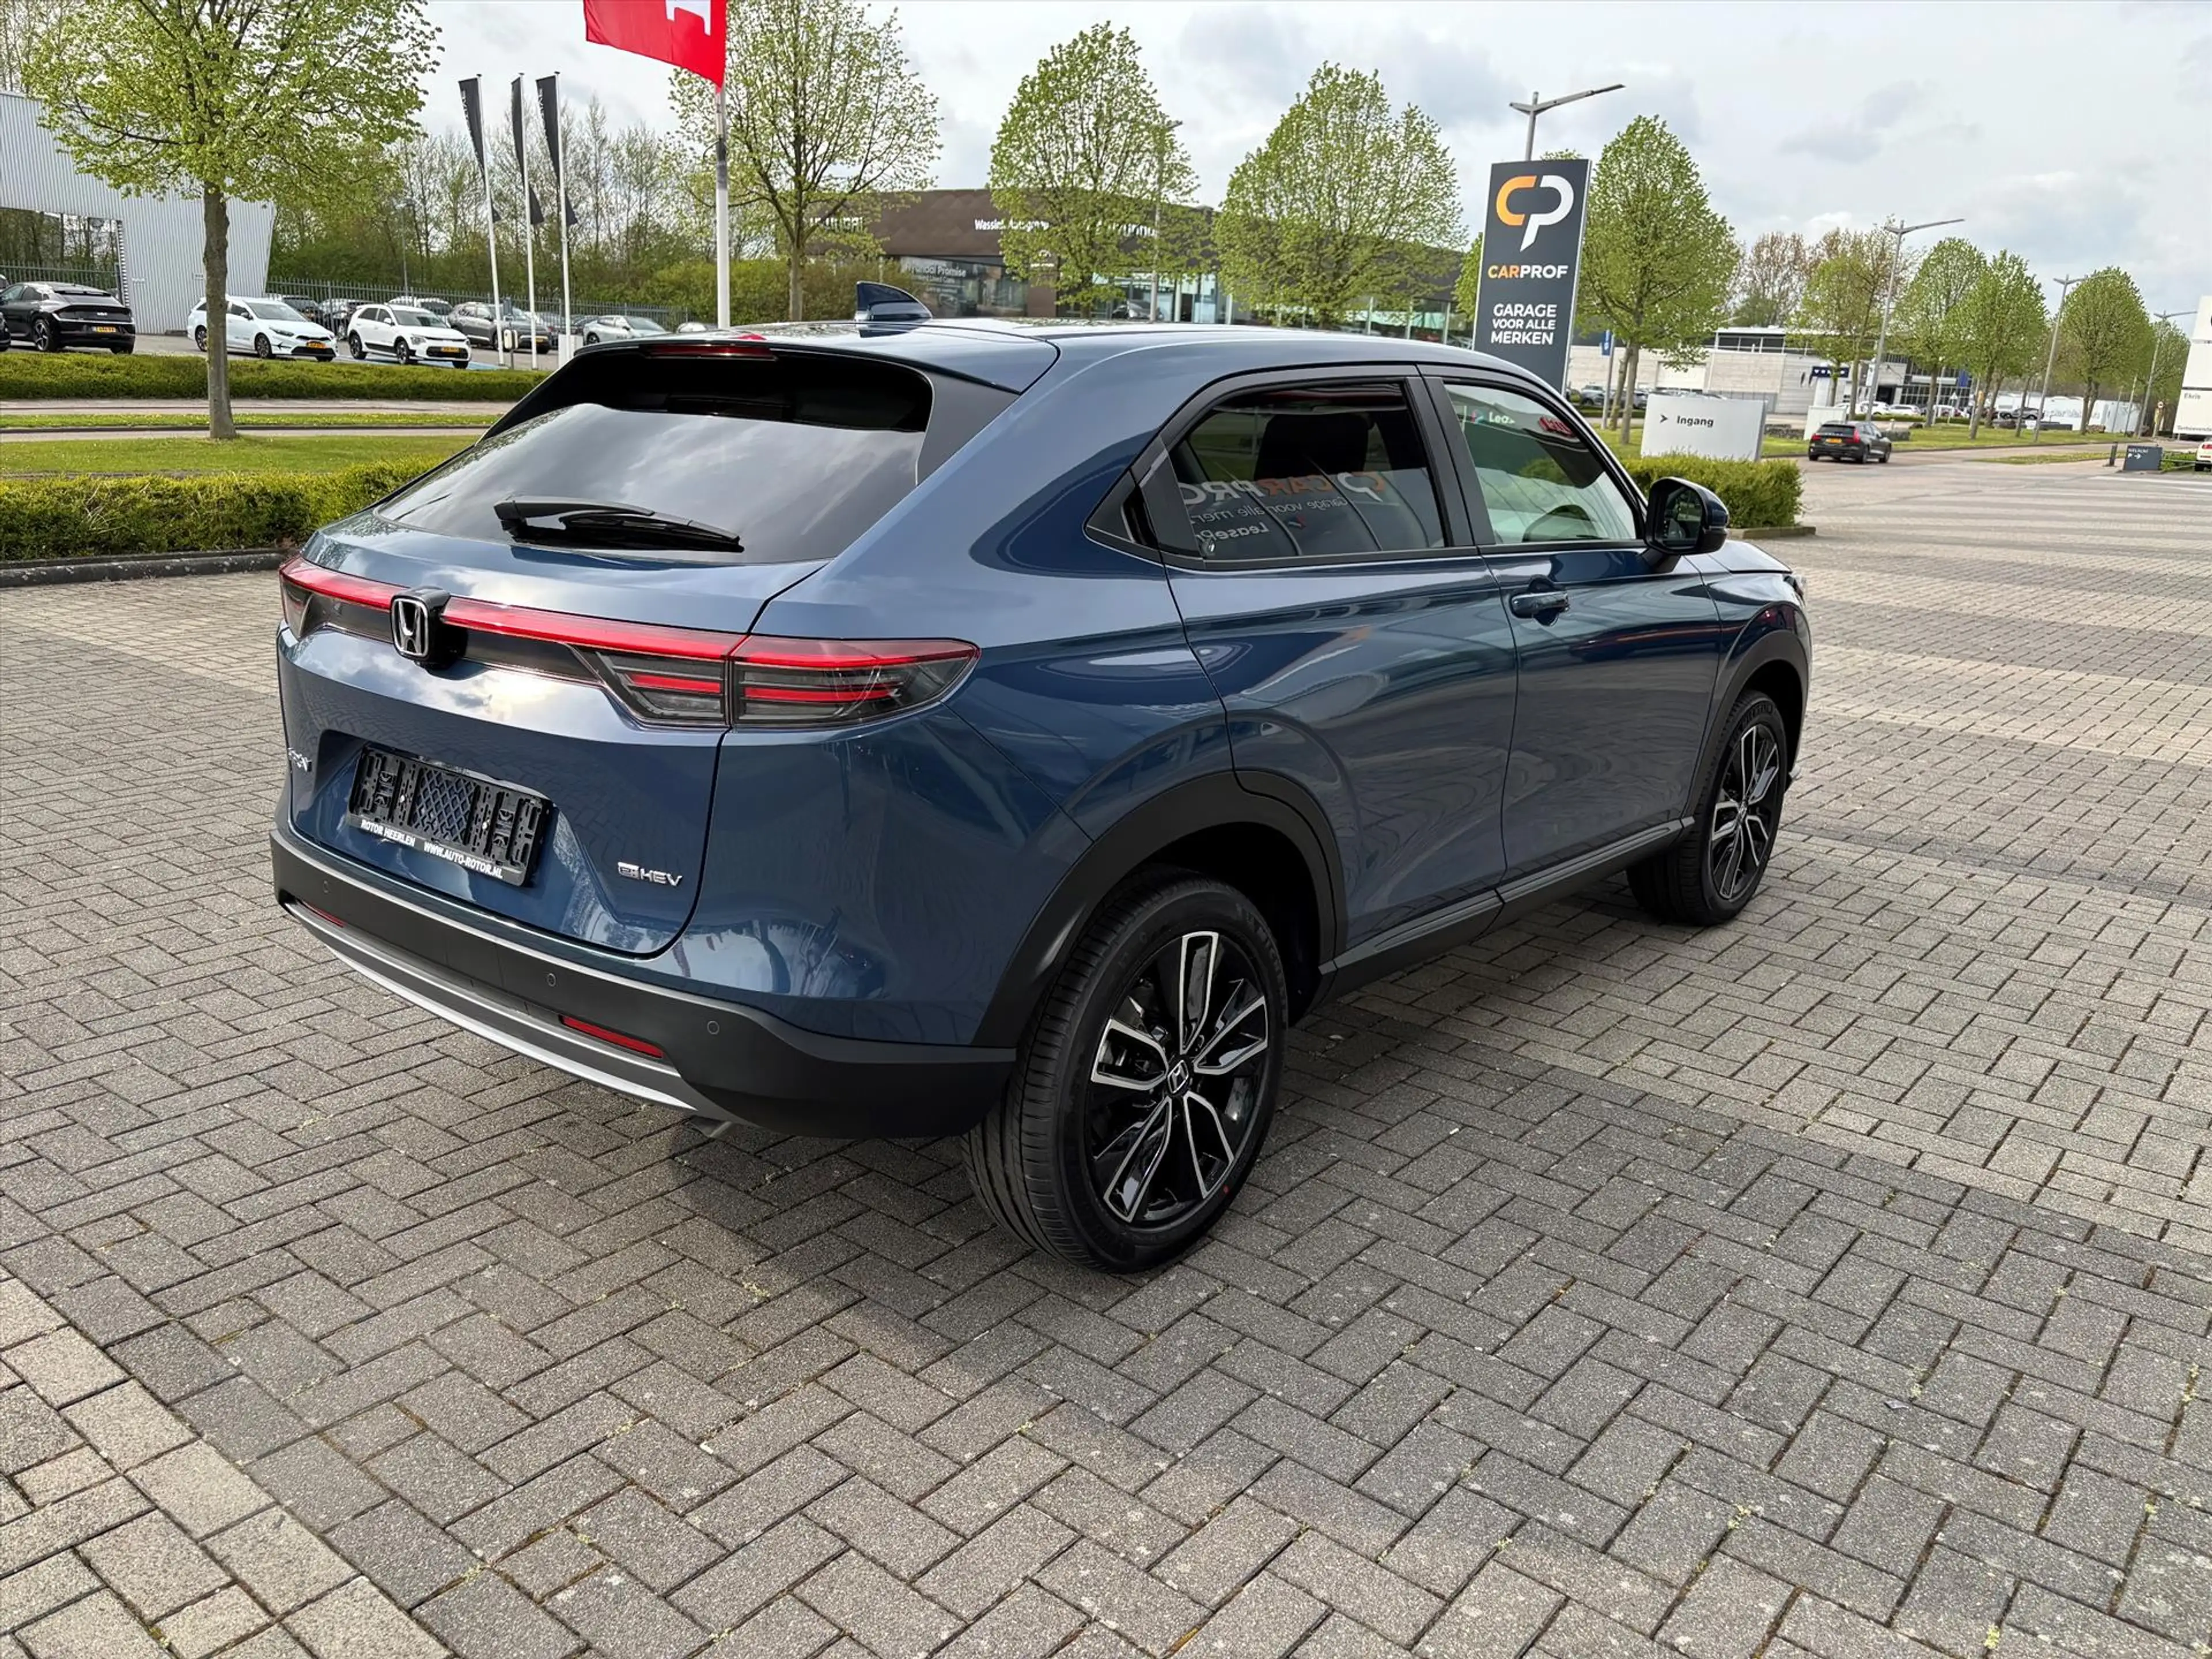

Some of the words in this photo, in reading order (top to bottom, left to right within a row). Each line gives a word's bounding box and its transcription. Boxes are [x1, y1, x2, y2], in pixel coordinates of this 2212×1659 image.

[1488, 265, 1569, 279] CARPROF
[1493, 304, 1558, 317] GARAGE
[1492, 319, 1524, 329] VOOR
[1525, 319, 1556, 330] ALLE
[1490, 331, 1554, 345] MERKEN
[1677, 415, 1714, 427] Ingang
[360, 819, 383, 836] ROTOR
[384, 825, 416, 847] HEERLEN
[423, 840, 503, 880] WWW.AUTO-ROTOR.NL
